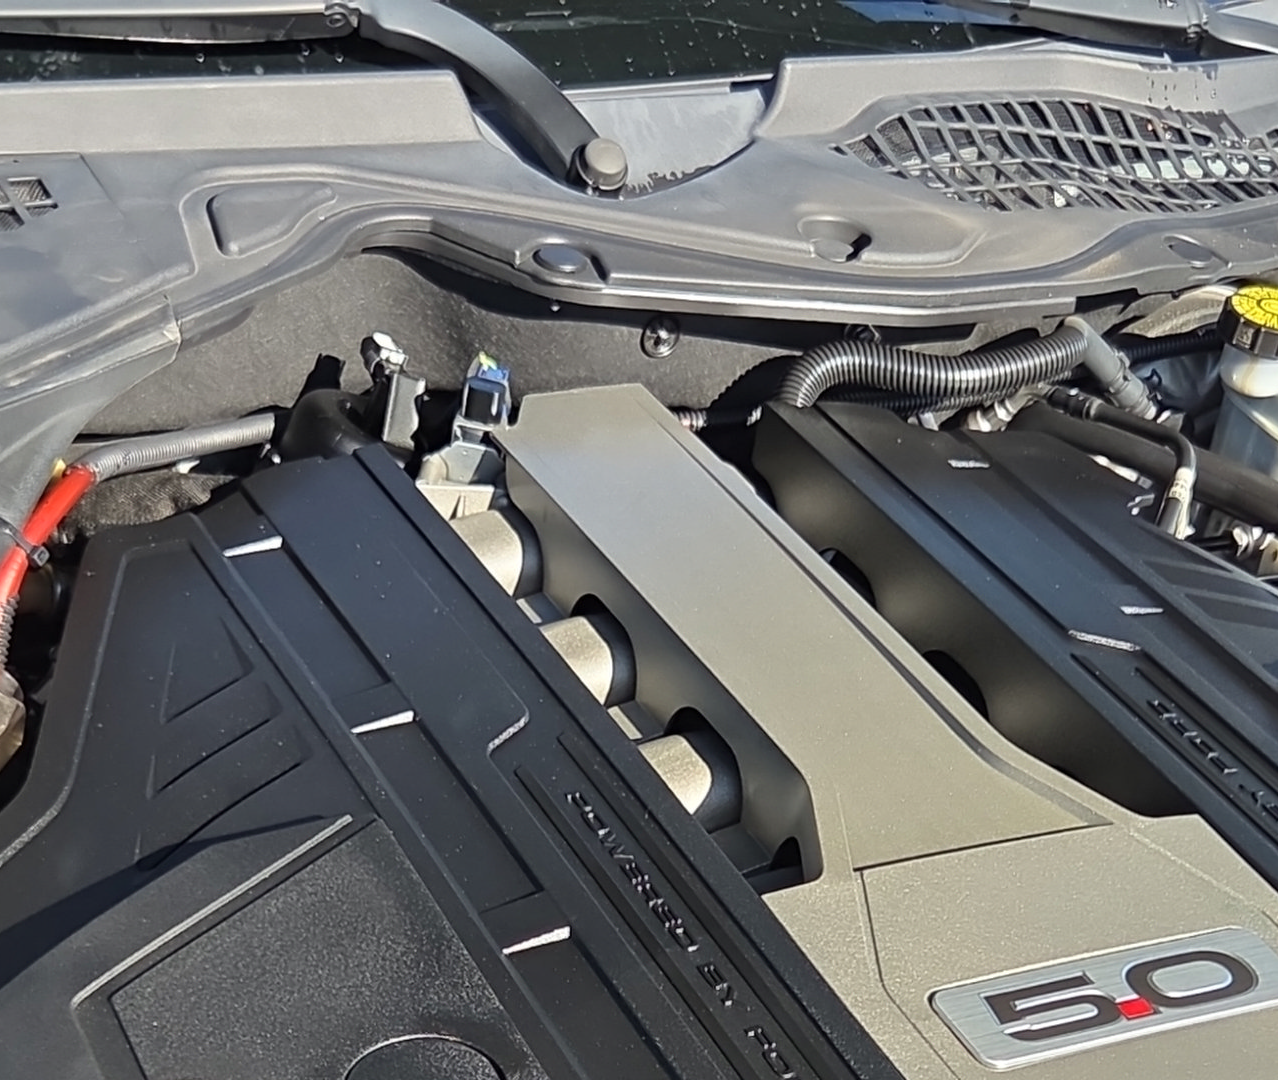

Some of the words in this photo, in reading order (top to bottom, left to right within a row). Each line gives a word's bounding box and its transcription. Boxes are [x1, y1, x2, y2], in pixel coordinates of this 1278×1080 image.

[565, 791, 700, 952] POWERED
[697, 963, 737, 1008] BY
[979, 949, 1260, 1042] 5.0
